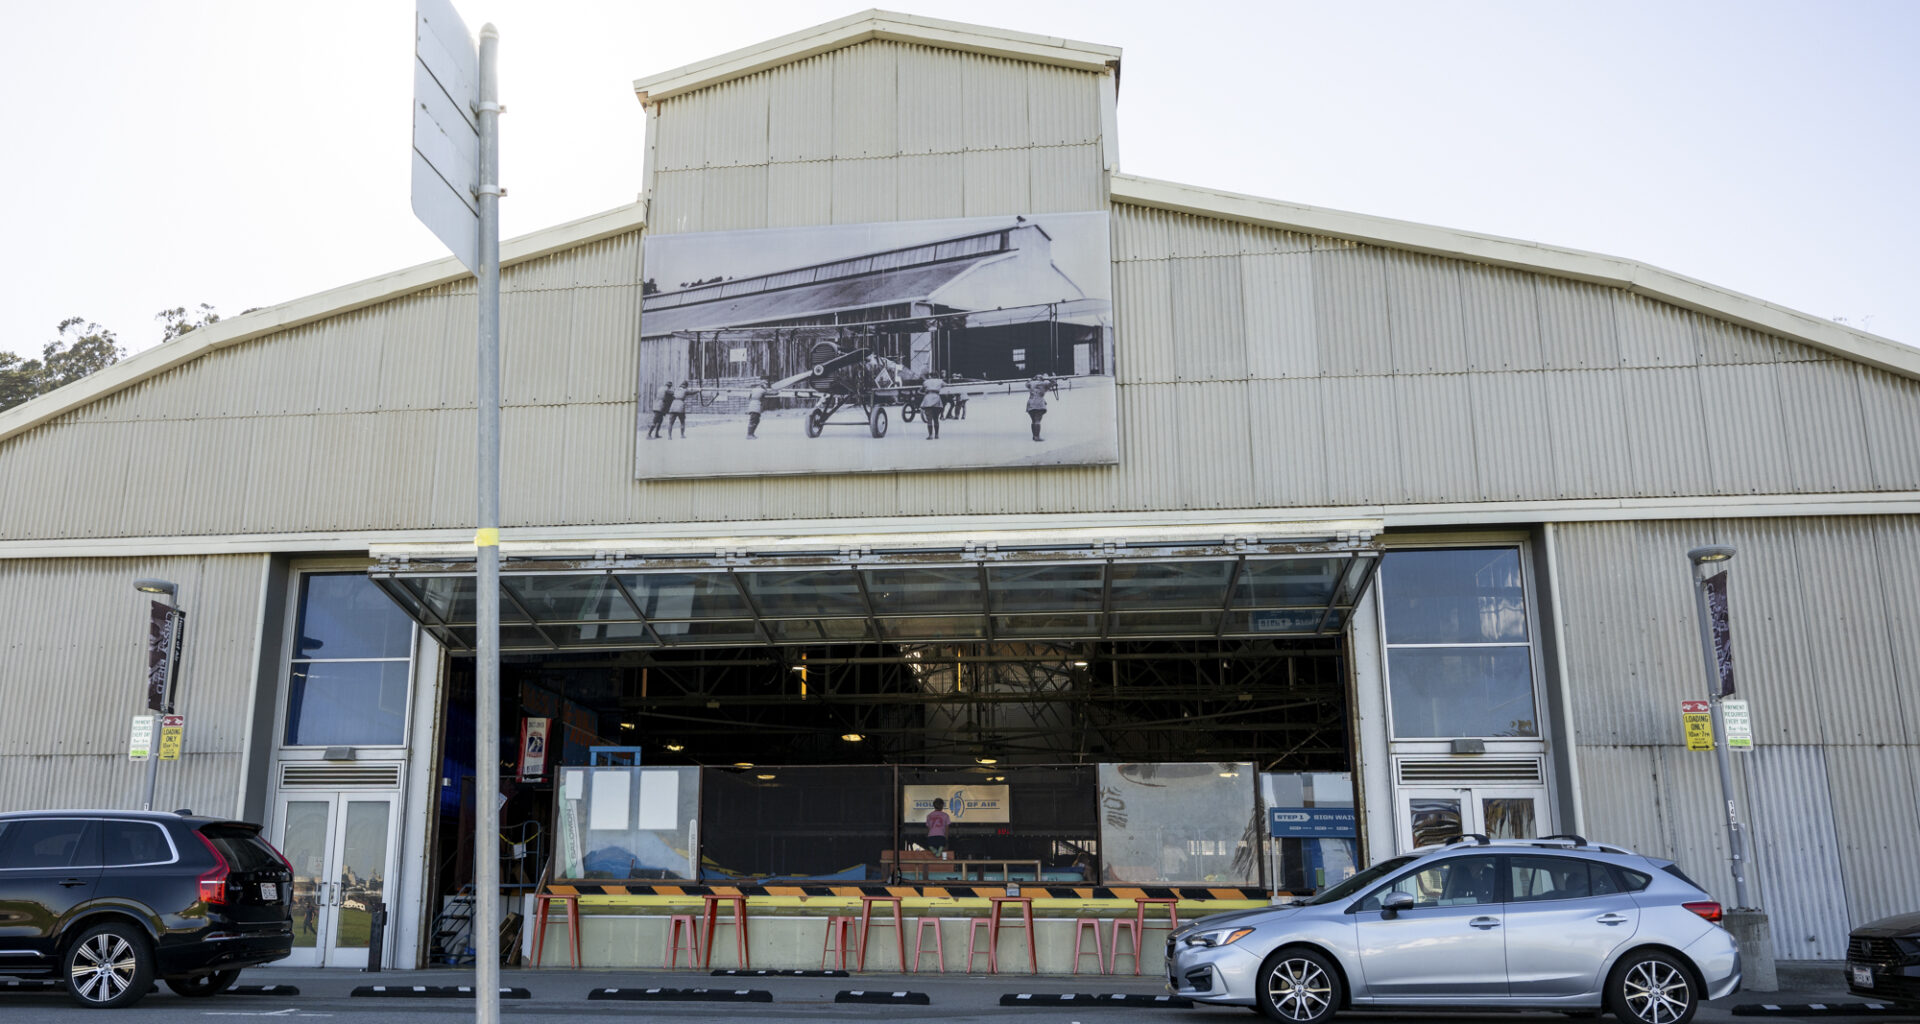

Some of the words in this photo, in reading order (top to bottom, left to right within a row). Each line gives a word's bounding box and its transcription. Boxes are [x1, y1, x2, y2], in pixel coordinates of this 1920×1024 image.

[156, 659, 167, 695] FIELD
[1685, 715, 1709, 723] LOADING
[566, 808, 577, 859] SALOMON
